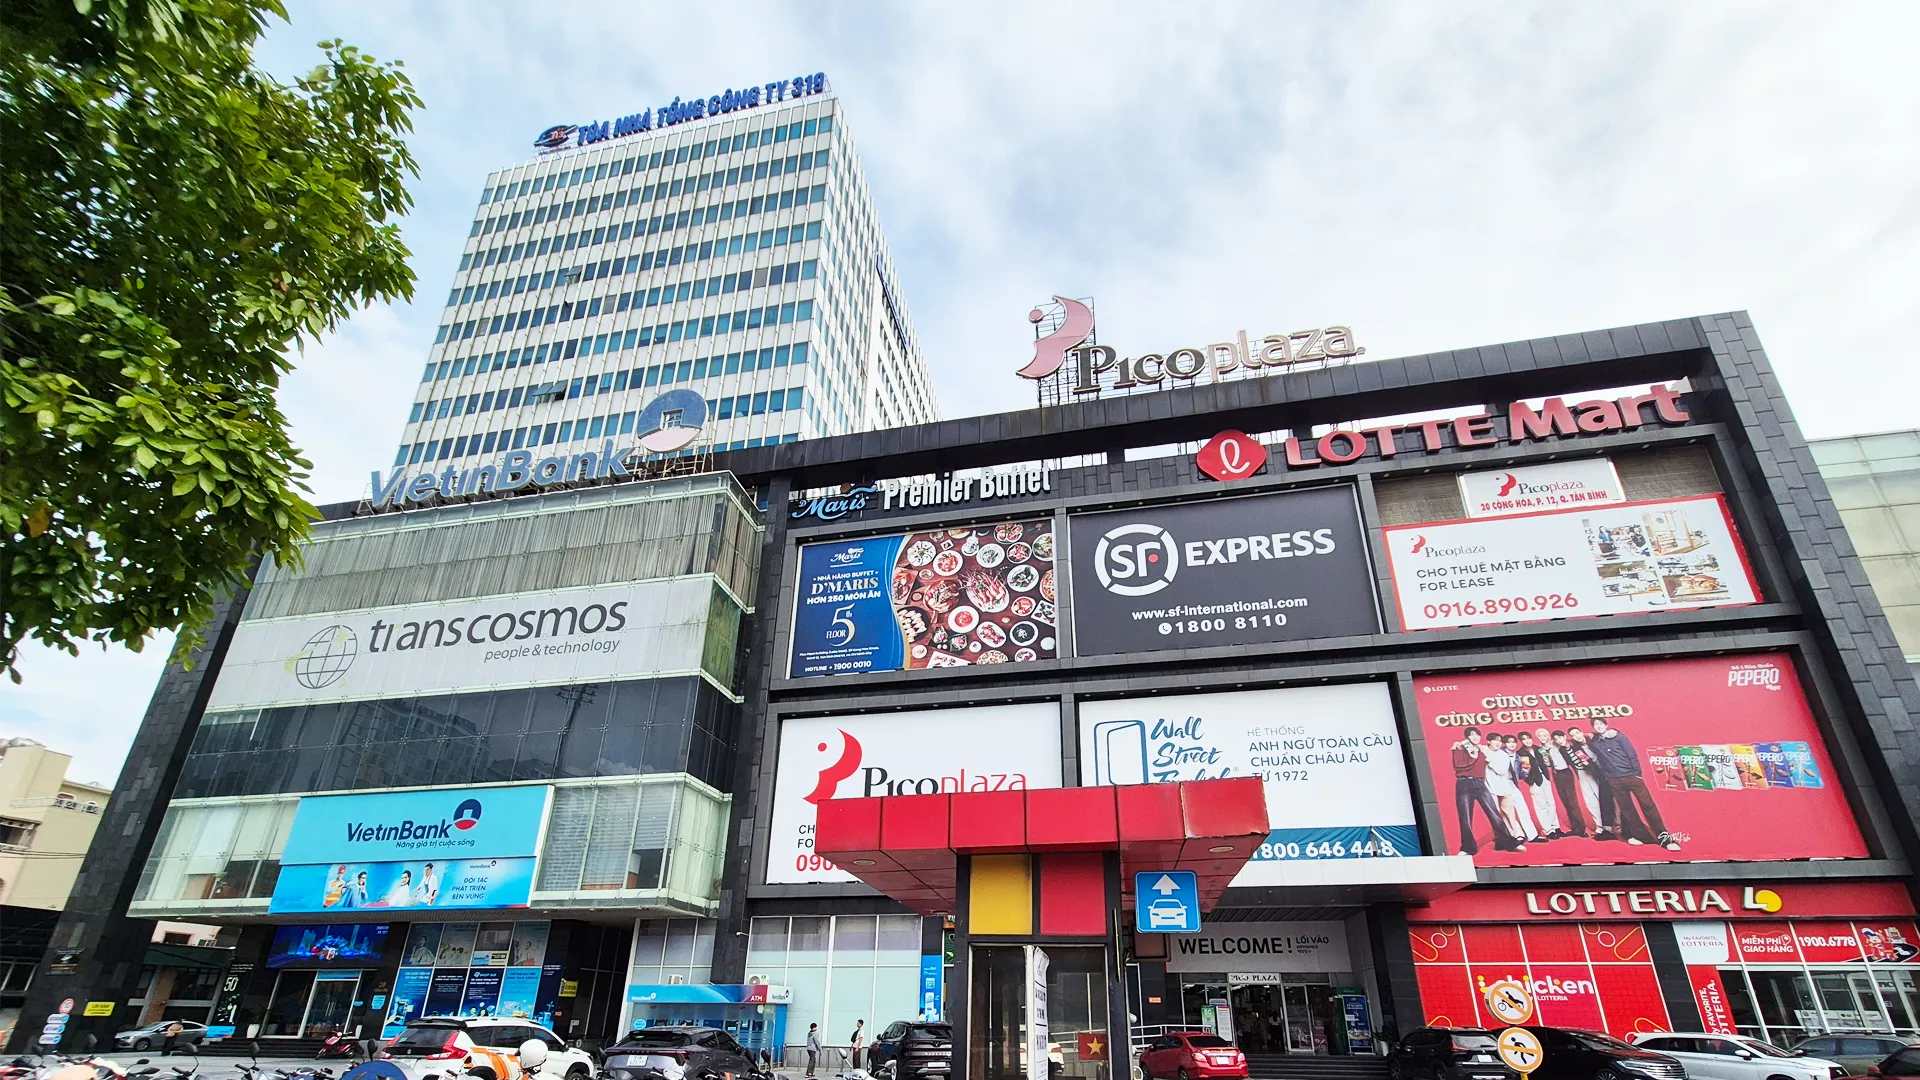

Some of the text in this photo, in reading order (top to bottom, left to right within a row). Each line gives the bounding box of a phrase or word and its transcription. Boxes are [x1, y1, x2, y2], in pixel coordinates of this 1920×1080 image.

[707, 88, 761, 116] CÔNG
[765, 81, 787, 103] TY
[791, 72, 825, 98] 319
[1284, 383, 1690, 467] LOTTE Mart
[371, 439, 637, 507] VietinBank
[884, 472, 974, 511] Premier
[980, 461, 1051, 500] Buffet
[1518, 480, 1585, 494] Picoplaza
[1480, 503, 1490, 511] 20
[1185, 528, 1336, 567] EXPRESS
[1424, 543, 1486, 558] Picoplaza
[852, 570, 875, 578] BUFFET
[1416, 564, 1448, 578] CHO
[1450, 561, 1488, 576] THUÊ
[1491, 559, 1521, 573] MẶT
[1419, 576, 1495, 592] FOR LEASE
[827, 595, 844, 603] 250
[845, 592, 867, 601] MÓN
[1423, 592, 1579, 620] 0916.890.926
[1132, 597, 1308, 620] www.sf-international.com
[368, 601, 628, 653] transcosmos
[1175, 613, 1287, 633] 1800 8110
[826, 629, 847, 639] FLOOR
[484, 638, 621, 663] people & technology
[834, 662, 852, 671] 1900
[853, 660, 872, 669] 0010
[1728, 668, 1780, 687] PEPERO
[1431, 684, 1459, 692] LOTTE
[1481, 692, 1576, 710] CÙNG VUI
[1435, 703, 1634, 728] CÙNG CHIA PEPERO
[1150, 716, 1205, 740] Wall
[1249, 740, 1279, 752] ANH
[1318, 735, 1359, 749] TOÀN
[1152, 742, 1224, 767] Street
[1305, 751, 1345, 765] CHÂU
[1350, 750, 1369, 763] ÂU
[1650, 755, 1678, 766] PEPERO
[1275, 770, 1308, 781] 1972
[347, 819, 453, 842] VietinBank
[1305, 841, 1345, 858] 646
[1526, 889, 1731, 914] LOTTERIA
[1310, 935, 1329, 944] VÀO
[1766, 935, 1783, 945] PHÍ
[1799, 936, 1857, 947] 1900.6778
[1767, 945, 1794, 953] HÀNG
[223, 977, 239, 991] 50
